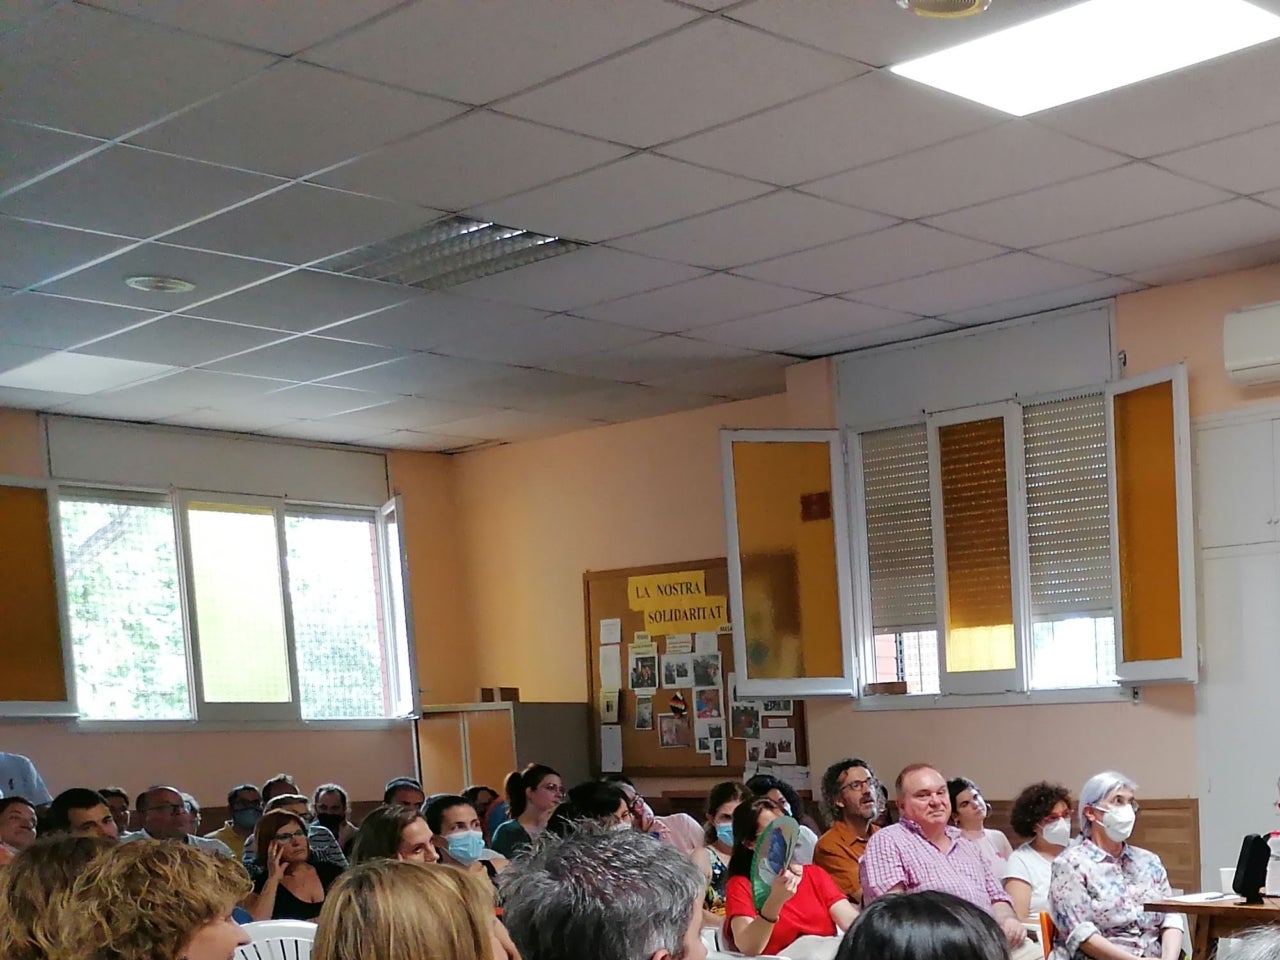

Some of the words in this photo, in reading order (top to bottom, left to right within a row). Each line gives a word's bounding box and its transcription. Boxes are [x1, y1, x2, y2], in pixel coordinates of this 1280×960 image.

[635, 586, 650, 599] LA
[657, 582, 701, 596] NOSTRA
[648, 605, 724, 624] SOLIDARITAT
